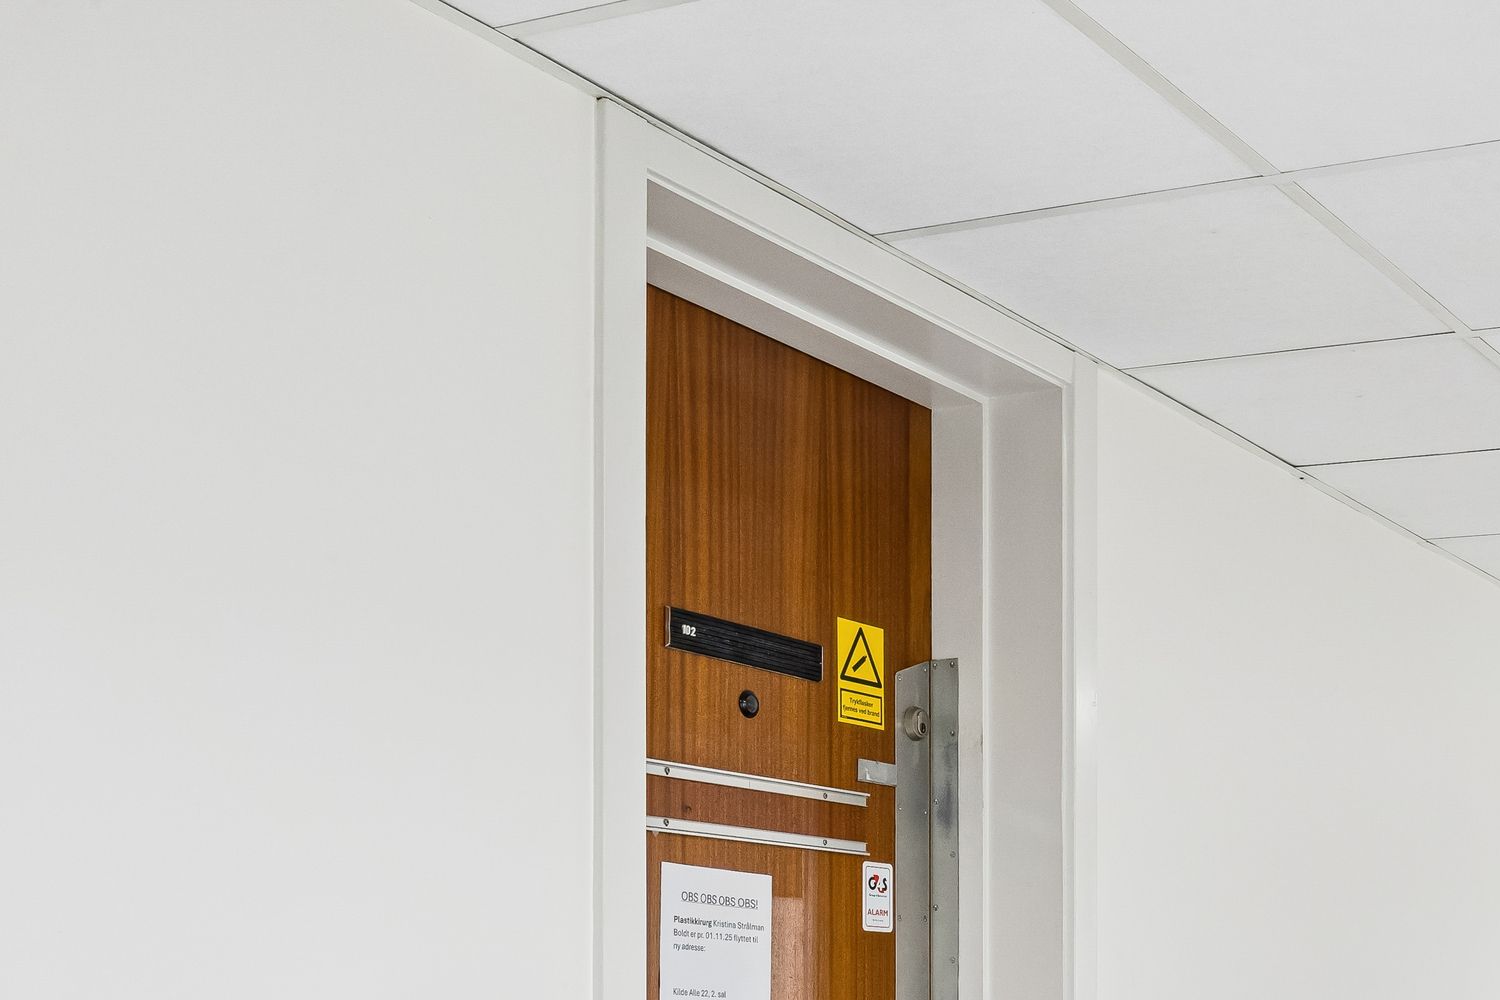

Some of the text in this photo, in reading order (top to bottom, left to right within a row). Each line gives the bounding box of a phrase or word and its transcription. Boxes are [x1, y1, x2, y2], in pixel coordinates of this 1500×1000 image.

[682, 624, 697, 637] 102
[867, 709, 880, 718] brand
[681, 891, 759, 909] OBS OBS OBS OBS!
[867, 908, 889, 917] ALARM
[673, 915, 765, 932] Plastikkirurg Kristina Strålman
[673, 928, 690, 937] Boldt
[697, 932, 705, 940] pr.
[705, 931, 733, 941] 01.11.25
[733, 934, 752, 944] flyttet
[673, 942, 706, 952] ny adresse:
[673, 988, 688, 996] Kilde
[701, 989, 711, 998] 22,
[711, 990, 717, 998] 2.
